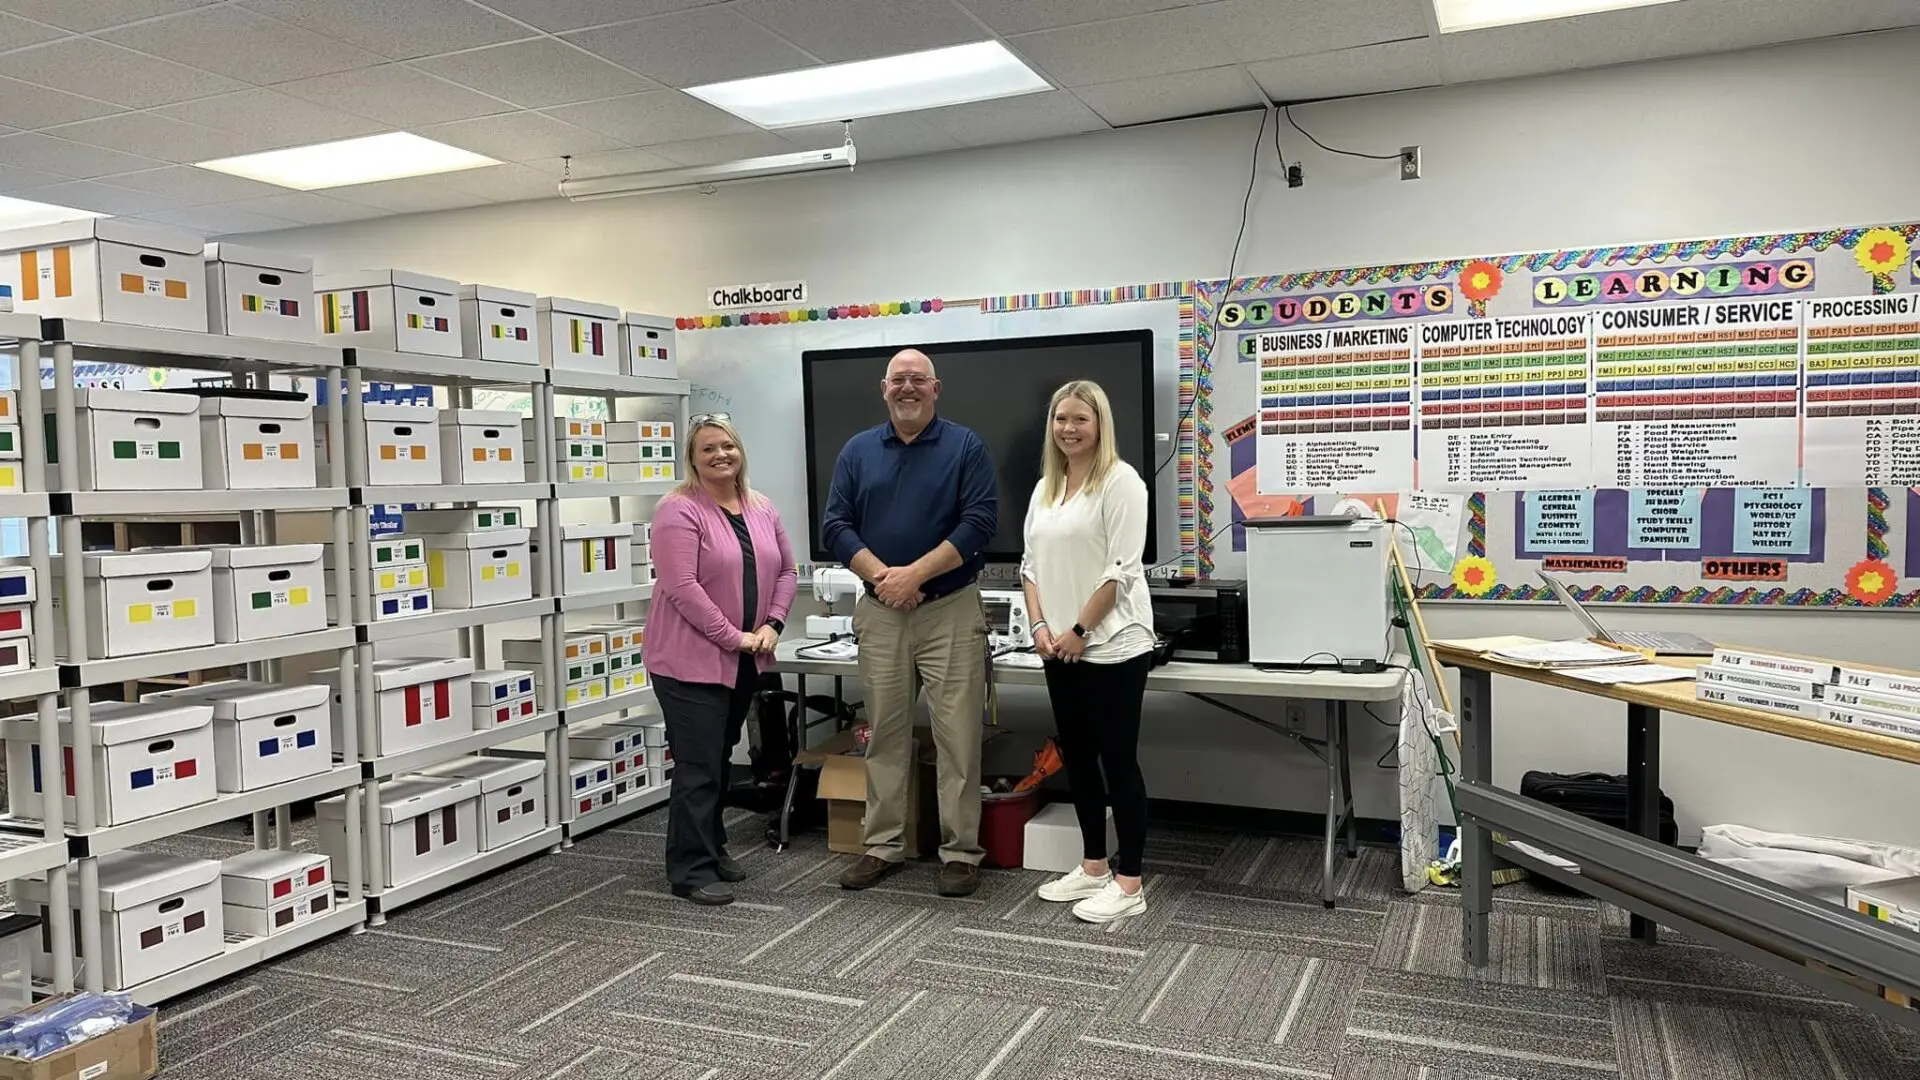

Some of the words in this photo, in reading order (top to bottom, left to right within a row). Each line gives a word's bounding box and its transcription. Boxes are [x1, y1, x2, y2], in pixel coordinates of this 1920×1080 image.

[1543, 264, 1808, 299] LEARNING
[713, 284, 803, 306] Chalkboard
[1602, 307, 1699, 329] CONSUMER
[1715, 302, 1793, 323] SERVICE
[1813, 298, 1908, 318] PROCESSING
[1262, 333, 1322, 351] BUSINESS
[1333, 328, 1408, 347] MARKETING
[1422, 323, 1492, 343] COMPUTER
[1495, 316, 1586, 338] TECHNOLOGY
[1546, 560, 1624, 569] MATHEMATICS
[1706, 561, 1781, 576] OTHERS
